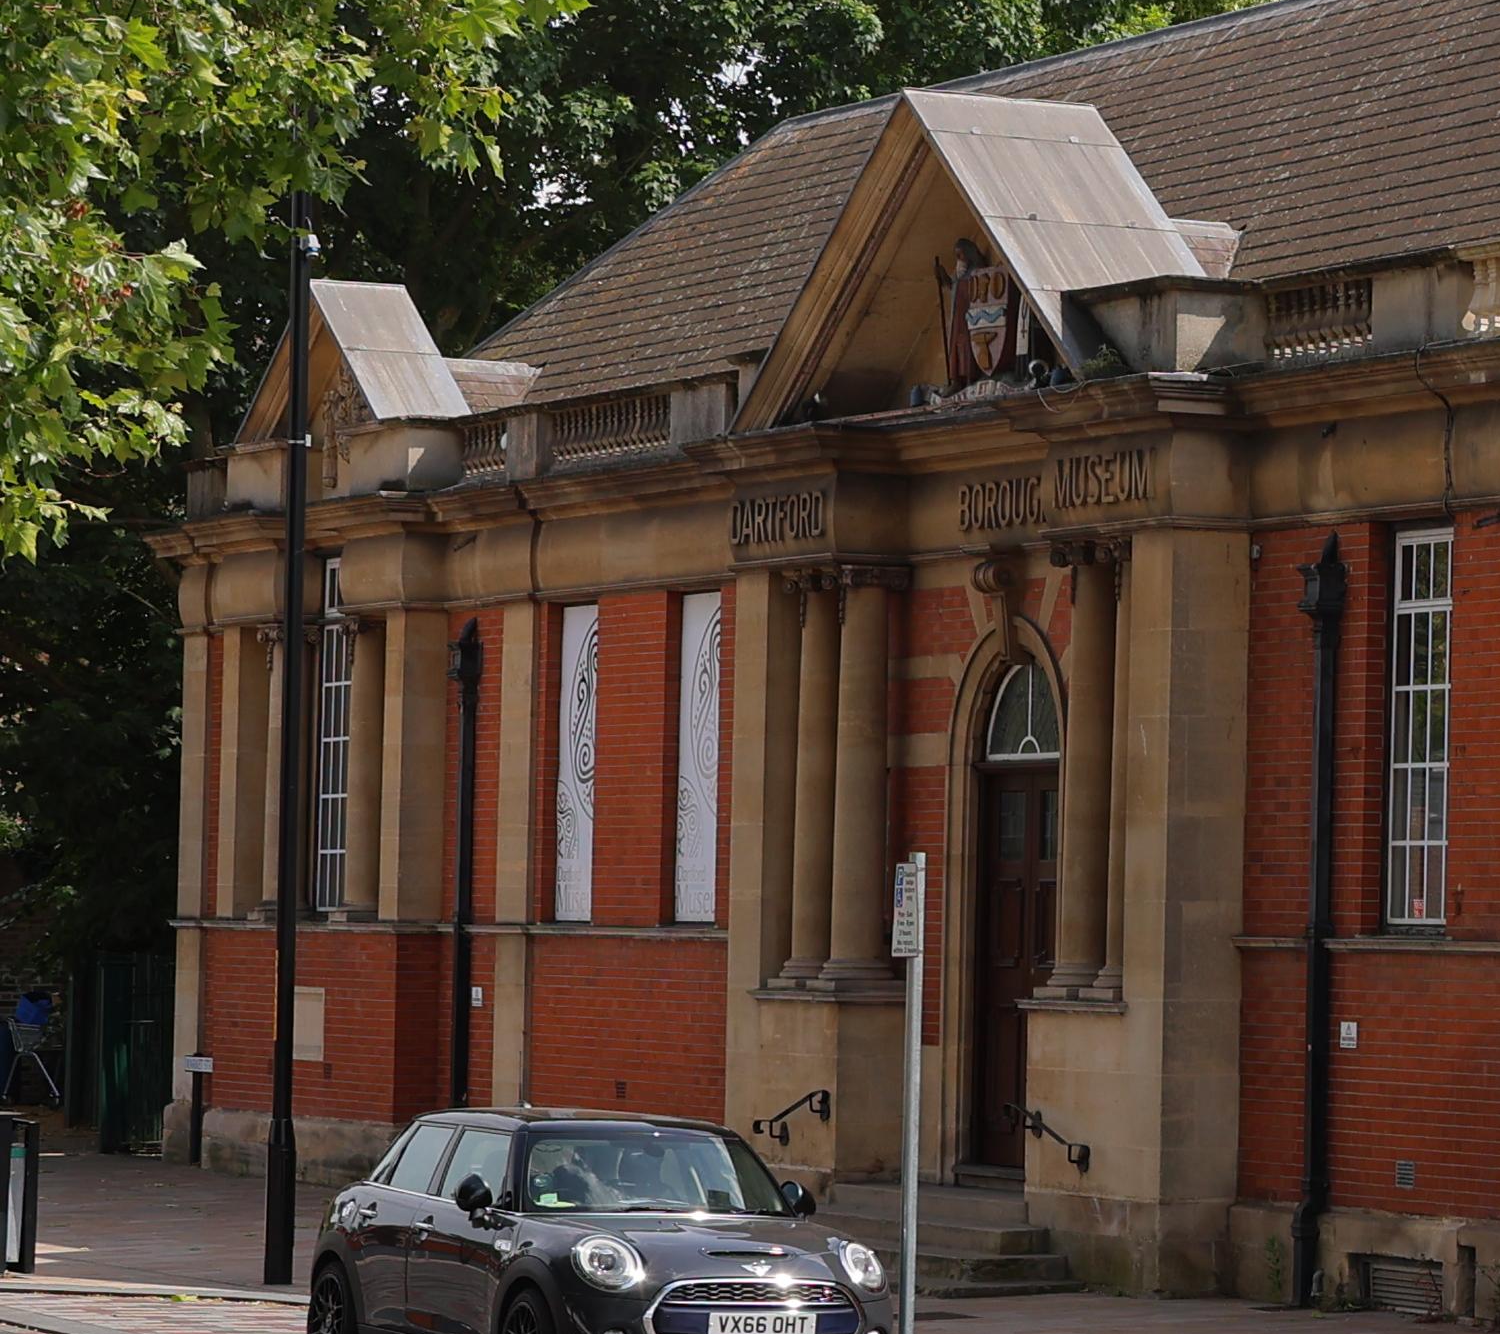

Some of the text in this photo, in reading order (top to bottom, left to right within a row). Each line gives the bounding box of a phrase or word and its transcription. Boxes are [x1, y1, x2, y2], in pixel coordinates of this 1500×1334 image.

[730, 449, 1153, 544] DARTFORD BOROUG MUSEUM
[718, 1316, 766, 1334] VX66
